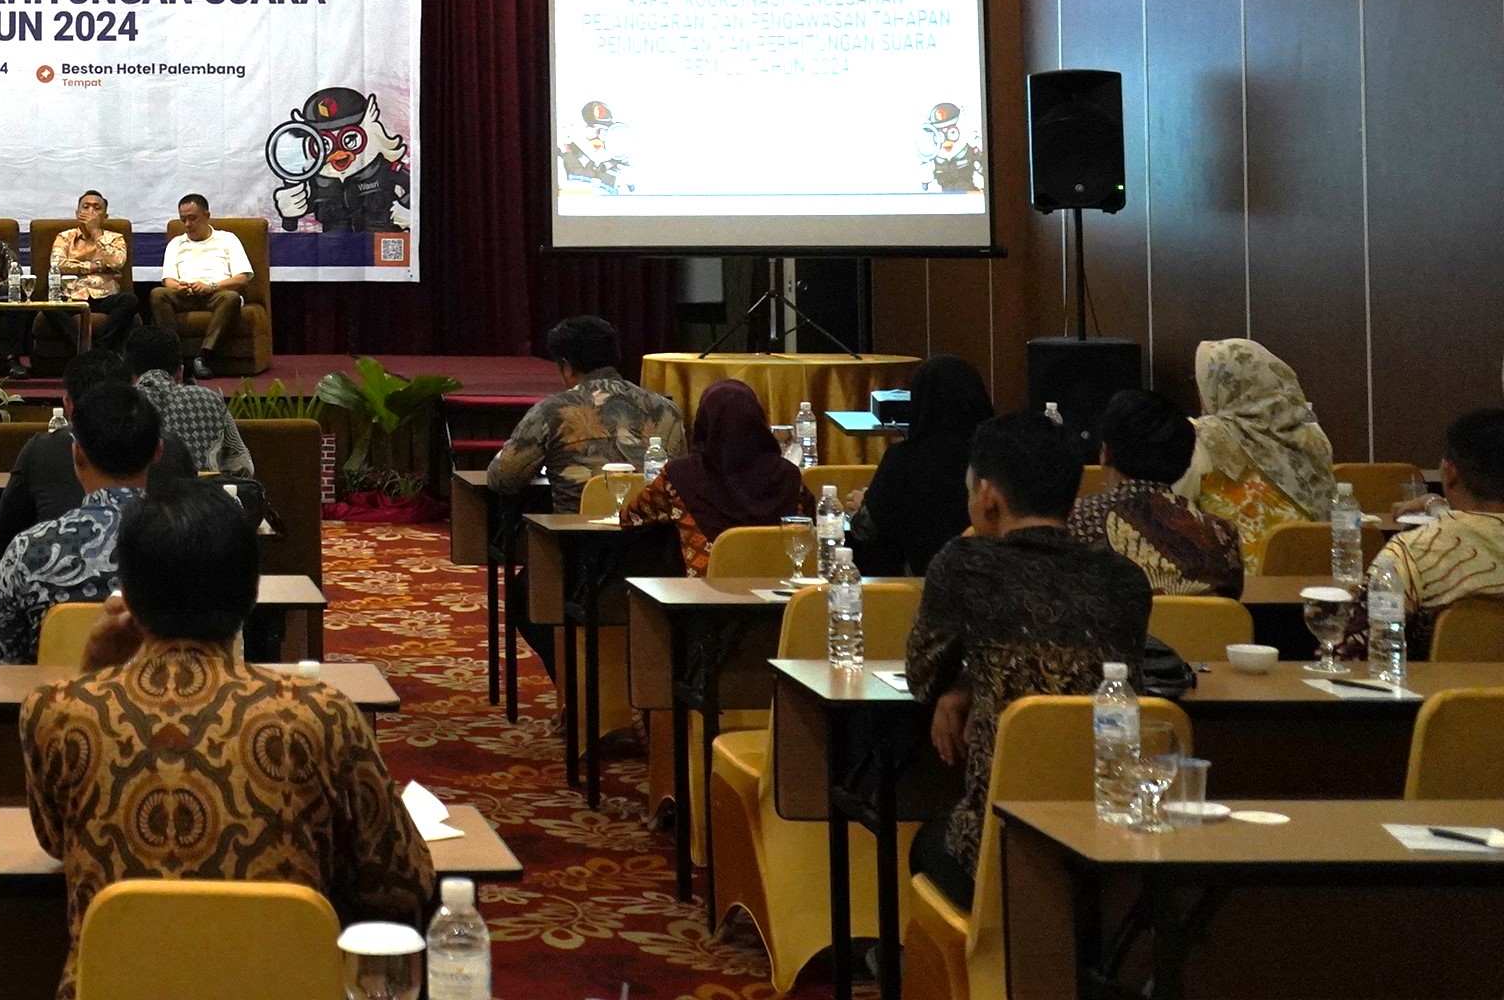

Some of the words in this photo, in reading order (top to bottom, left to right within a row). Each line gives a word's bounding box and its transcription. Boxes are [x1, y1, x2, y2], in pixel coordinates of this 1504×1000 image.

[54, 11, 139, 42] 2024
[583, 13, 705, 31] PELANGGARAN
[751, 11, 866, 31] PENGAWASAN
[872, 9, 951, 29] TAHAPAN
[880, 32, 938, 52] SUARA
[62, 62, 113, 75] Beston
[116, 62, 156, 75] Hotel
[159, 62, 246, 79] Palembang
[62, 78, 102, 89] Tempat
